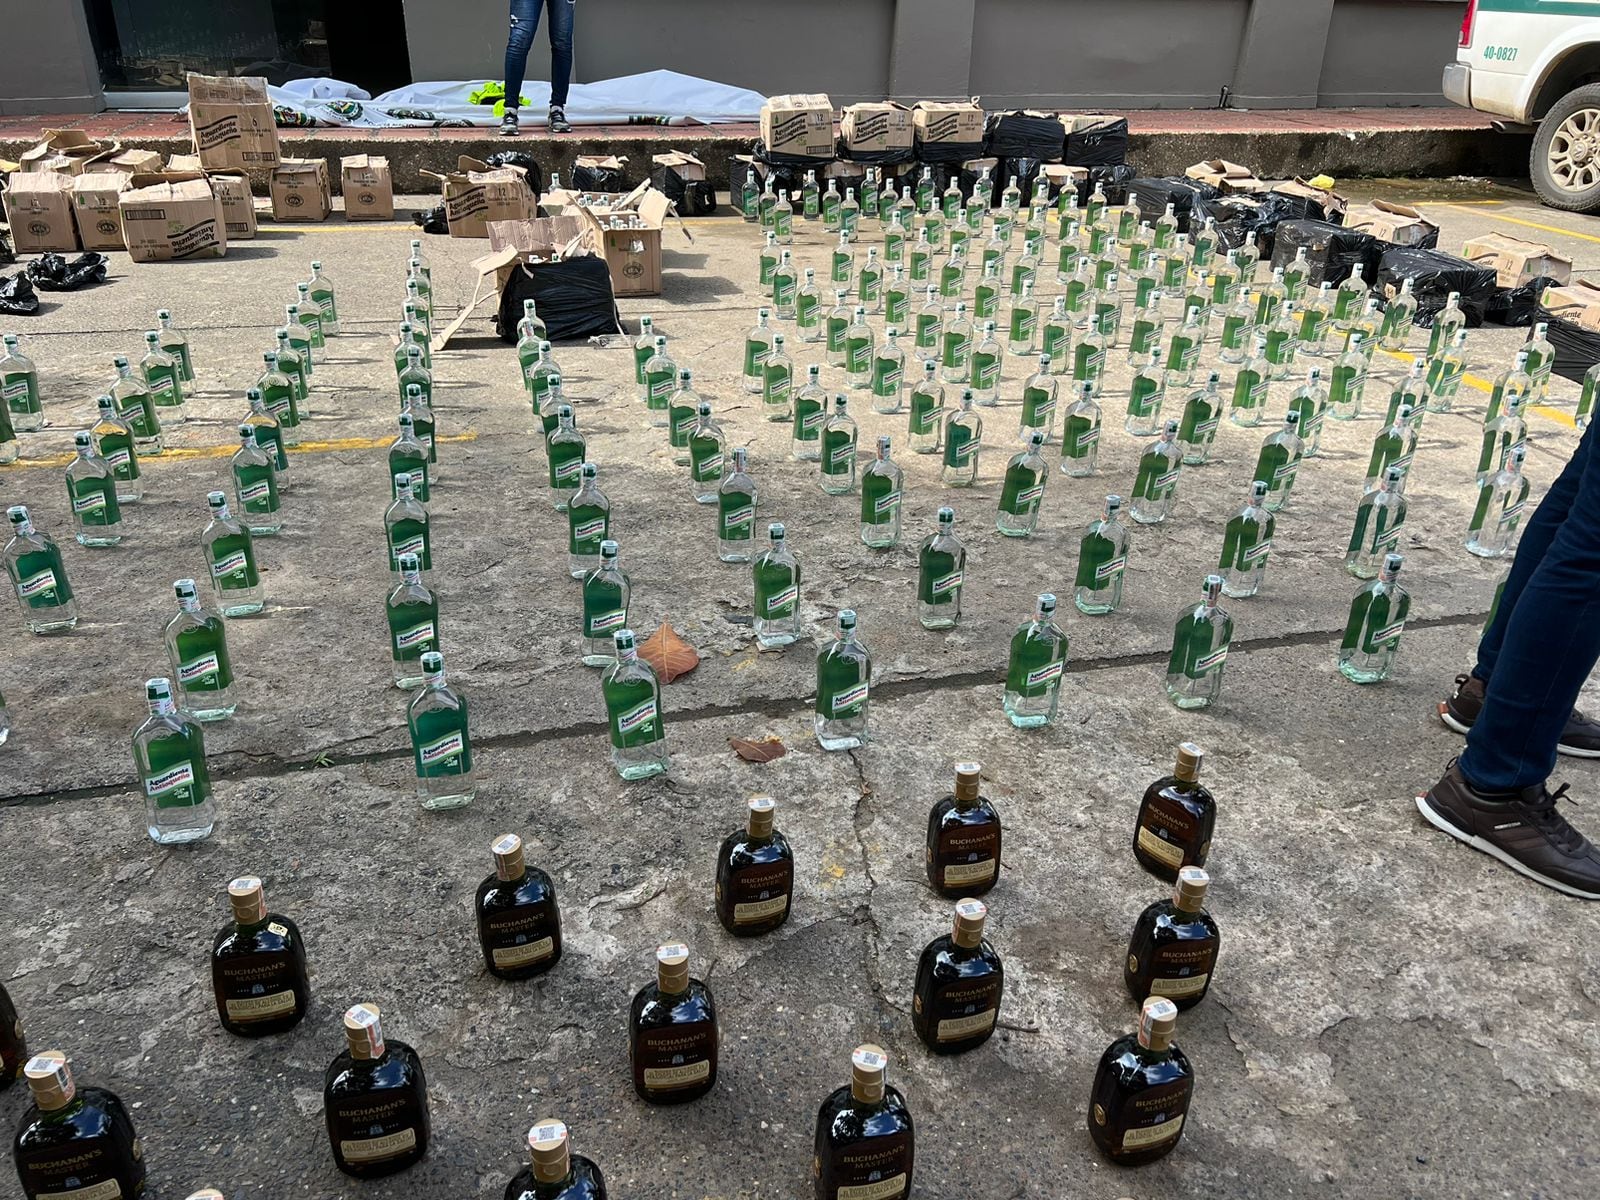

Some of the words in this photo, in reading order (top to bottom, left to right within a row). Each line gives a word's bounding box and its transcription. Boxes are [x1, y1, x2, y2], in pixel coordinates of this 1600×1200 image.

[1483, 45, 1518, 61] 40-0827
[816, 114, 824, 122] 12
[200, 121, 236, 139] Aguardiente
[201, 127, 237, 145] Antioqueño
[498, 188, 506, 196] 12
[1506, 260, 1513, 270] 12
[180, 658, 214, 674] Aguardiente
[422, 738, 459, 756] Aguardiente
[150, 768, 189, 786] Aguardiente
[150, 772, 190, 791] Antioqueño
[950, 832, 996, 844] BUCHANAN'S
[741, 870, 788, 884] BUCHANAN'S
[490, 912, 544, 928] BUCHANAN'S
[501, 922, 536, 934] MASTER
[1162, 948, 1213, 958] BUCHANAN'S
[224, 961, 286, 976] BUCHANAN'S
[946, 983, 998, 998] BUCHANAN'S
[648, 1032, 706, 1046] BUCHANAN'S
[658, 1042, 696, 1052] MASTER
[339, 1098, 406, 1117] BUCHANAN'S
[352, 1110, 396, 1123] MASTER
[28, 1148, 102, 1170] BUCHANAN'S
[844, 1145, 905, 1163] BUCHANAN'S
[854, 1157, 894, 1170] MASTER
